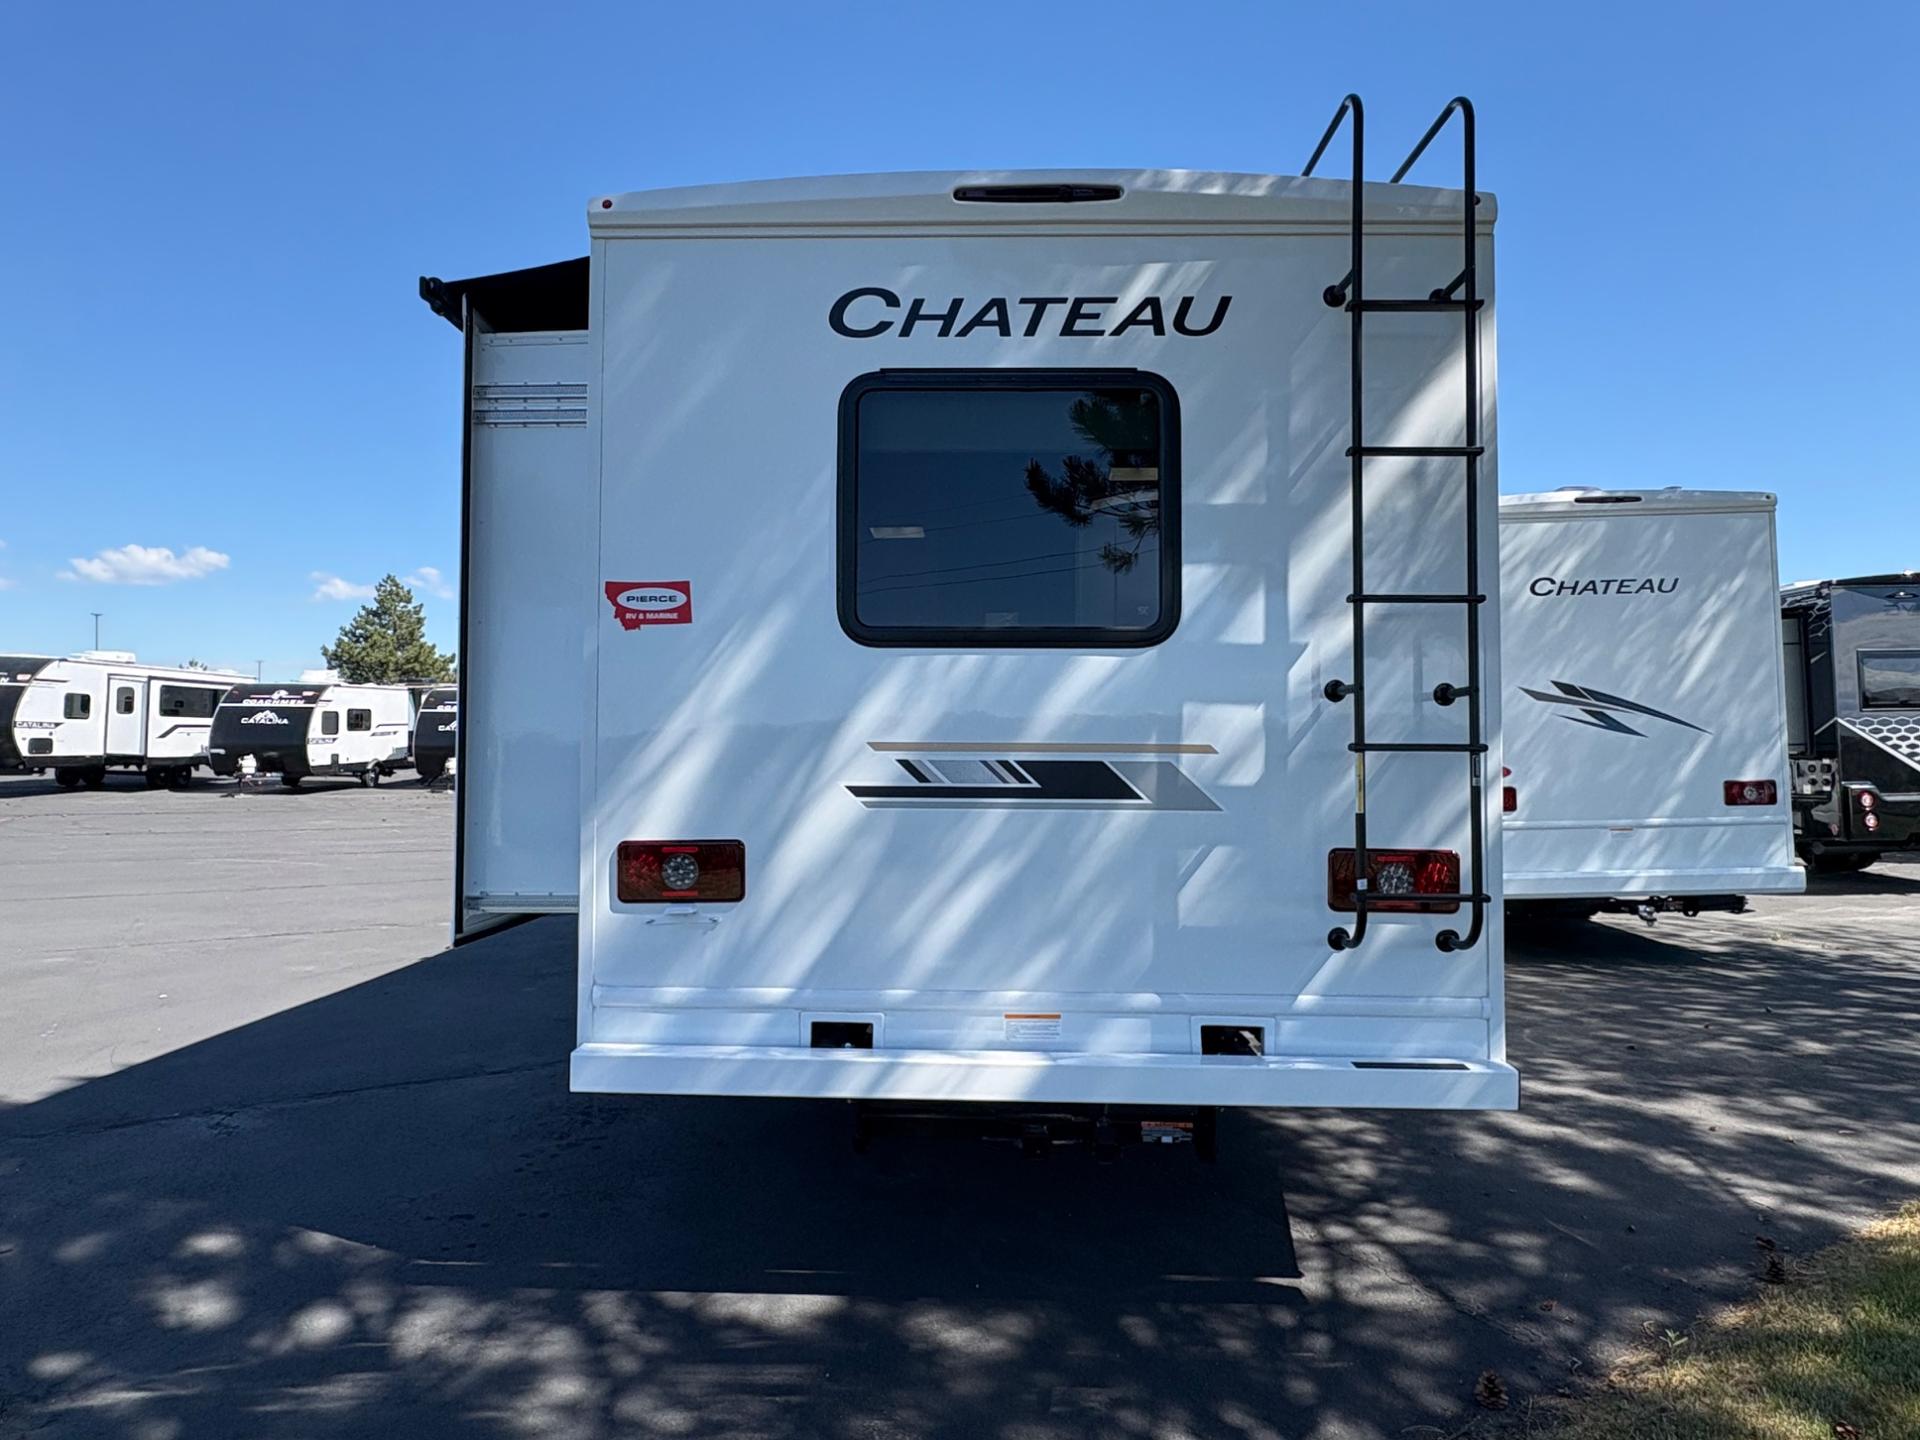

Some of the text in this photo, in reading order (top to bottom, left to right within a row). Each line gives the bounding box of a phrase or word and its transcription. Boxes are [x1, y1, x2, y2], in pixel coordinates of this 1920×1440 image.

[828, 287, 1233, 338] CHATEAU
[1529, 577, 1680, 596] CHATEAU
[626, 595, 678, 603] PIERCE
[625, 612, 679, 620] RV & MARINE
[241, 716, 289, 724] CATALINA
[15, 721, 57, 729] CATALINA
